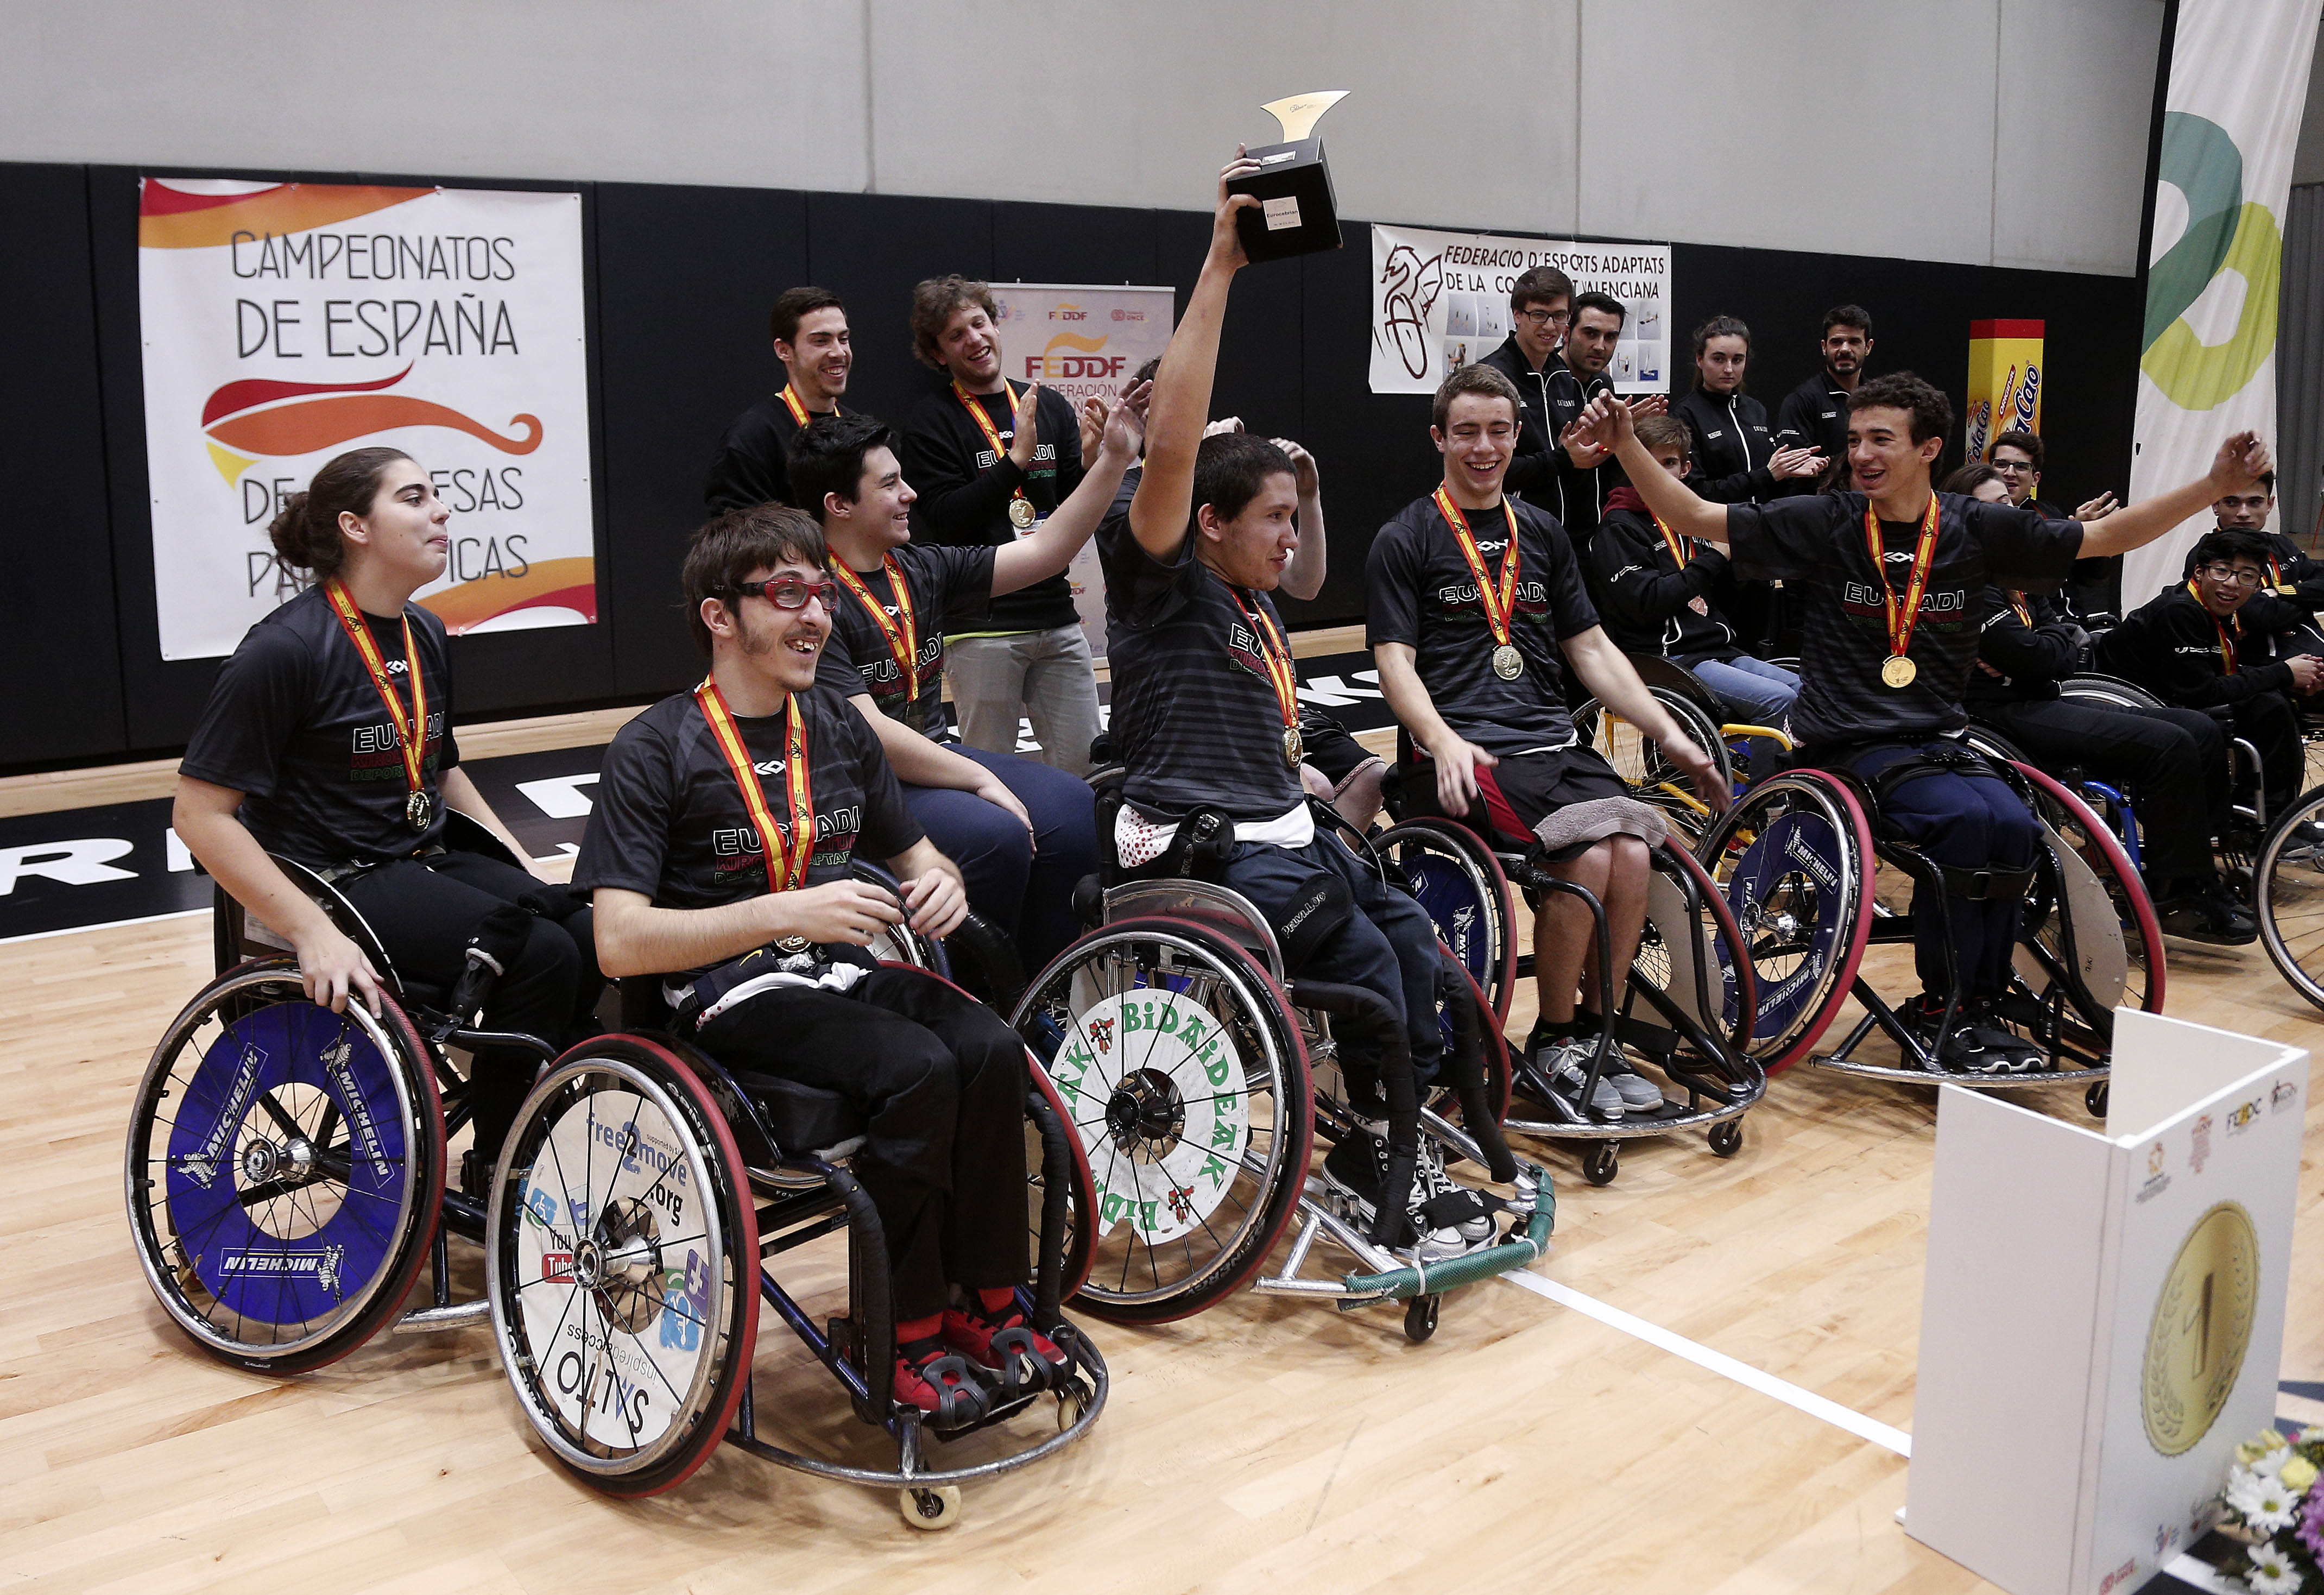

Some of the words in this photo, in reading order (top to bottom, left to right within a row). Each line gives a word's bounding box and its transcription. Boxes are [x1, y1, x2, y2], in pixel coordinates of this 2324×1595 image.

[231, 230, 516, 281] CAMPEONATOS
[1445, 245, 1523, 268] FEDERACIO
[1602, 256, 1664, 274] ADAPTATS
[1446, 272, 1462, 290] DE
[1469, 274, 1486, 292] LA
[235, 298, 302, 359] DE
[325, 293, 519, 358] ESPAÑA
[1026, 356, 1126, 378] FEDDF
[1046, 381, 1117, 397] DERACIÓN
[1999, 369, 2015, 416] ORIGINAL
[1844, 581, 1965, 611] EUADI
[1797, 844, 1839, 887] MICHELIN
[206, 1049, 259, 1157] MICHELIN
[340, 1071, 390, 1176] MICHELIN
[550, 1230, 571, 1250] You
[224, 1256, 319, 1271] MICHELIN
[2183, 1273, 2213, 1380] 1
[557, 1351, 649, 1434] SALTO
